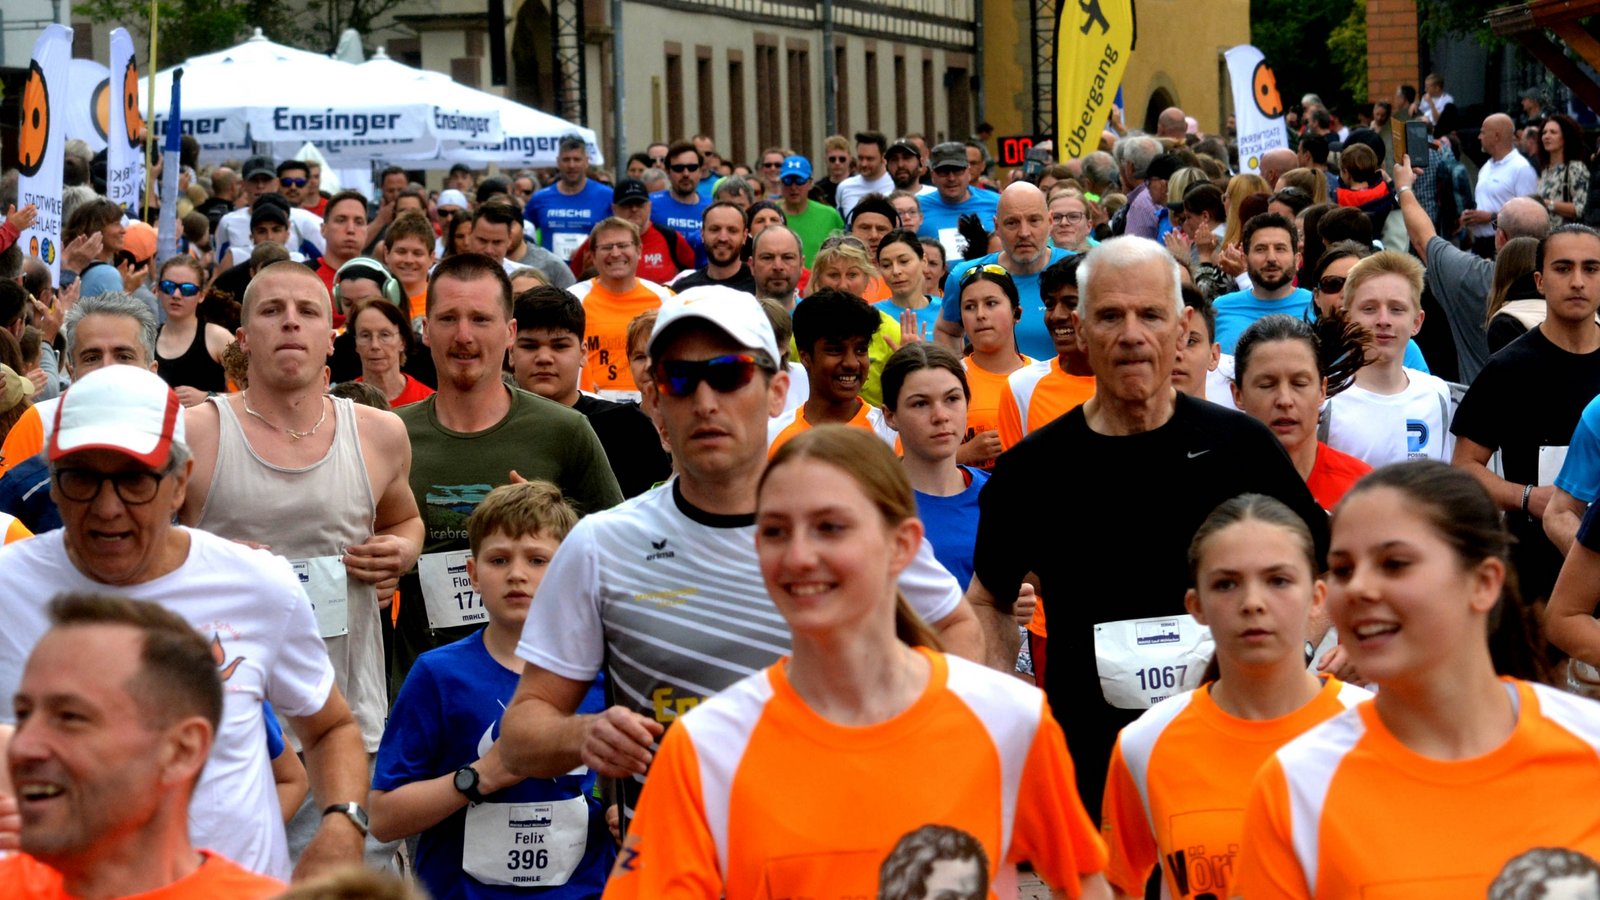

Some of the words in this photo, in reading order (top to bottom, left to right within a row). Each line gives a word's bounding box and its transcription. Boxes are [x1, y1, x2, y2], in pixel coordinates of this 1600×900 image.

[1065, 43, 1118, 159] Übergang
[273, 106, 402, 136] Ensinger
[434, 105, 491, 138] Ensinger
[666, 217, 704, 229] RISCH
[429, 526, 469, 540] icebre
[646, 550, 675, 562] erima
[462, 612, 486, 622] MAHLE
[1135, 664, 1188, 691] 1067
[514, 832, 545, 845] Felix
[506, 848, 549, 871] 396
[512, 875, 541, 883] MAHLE
